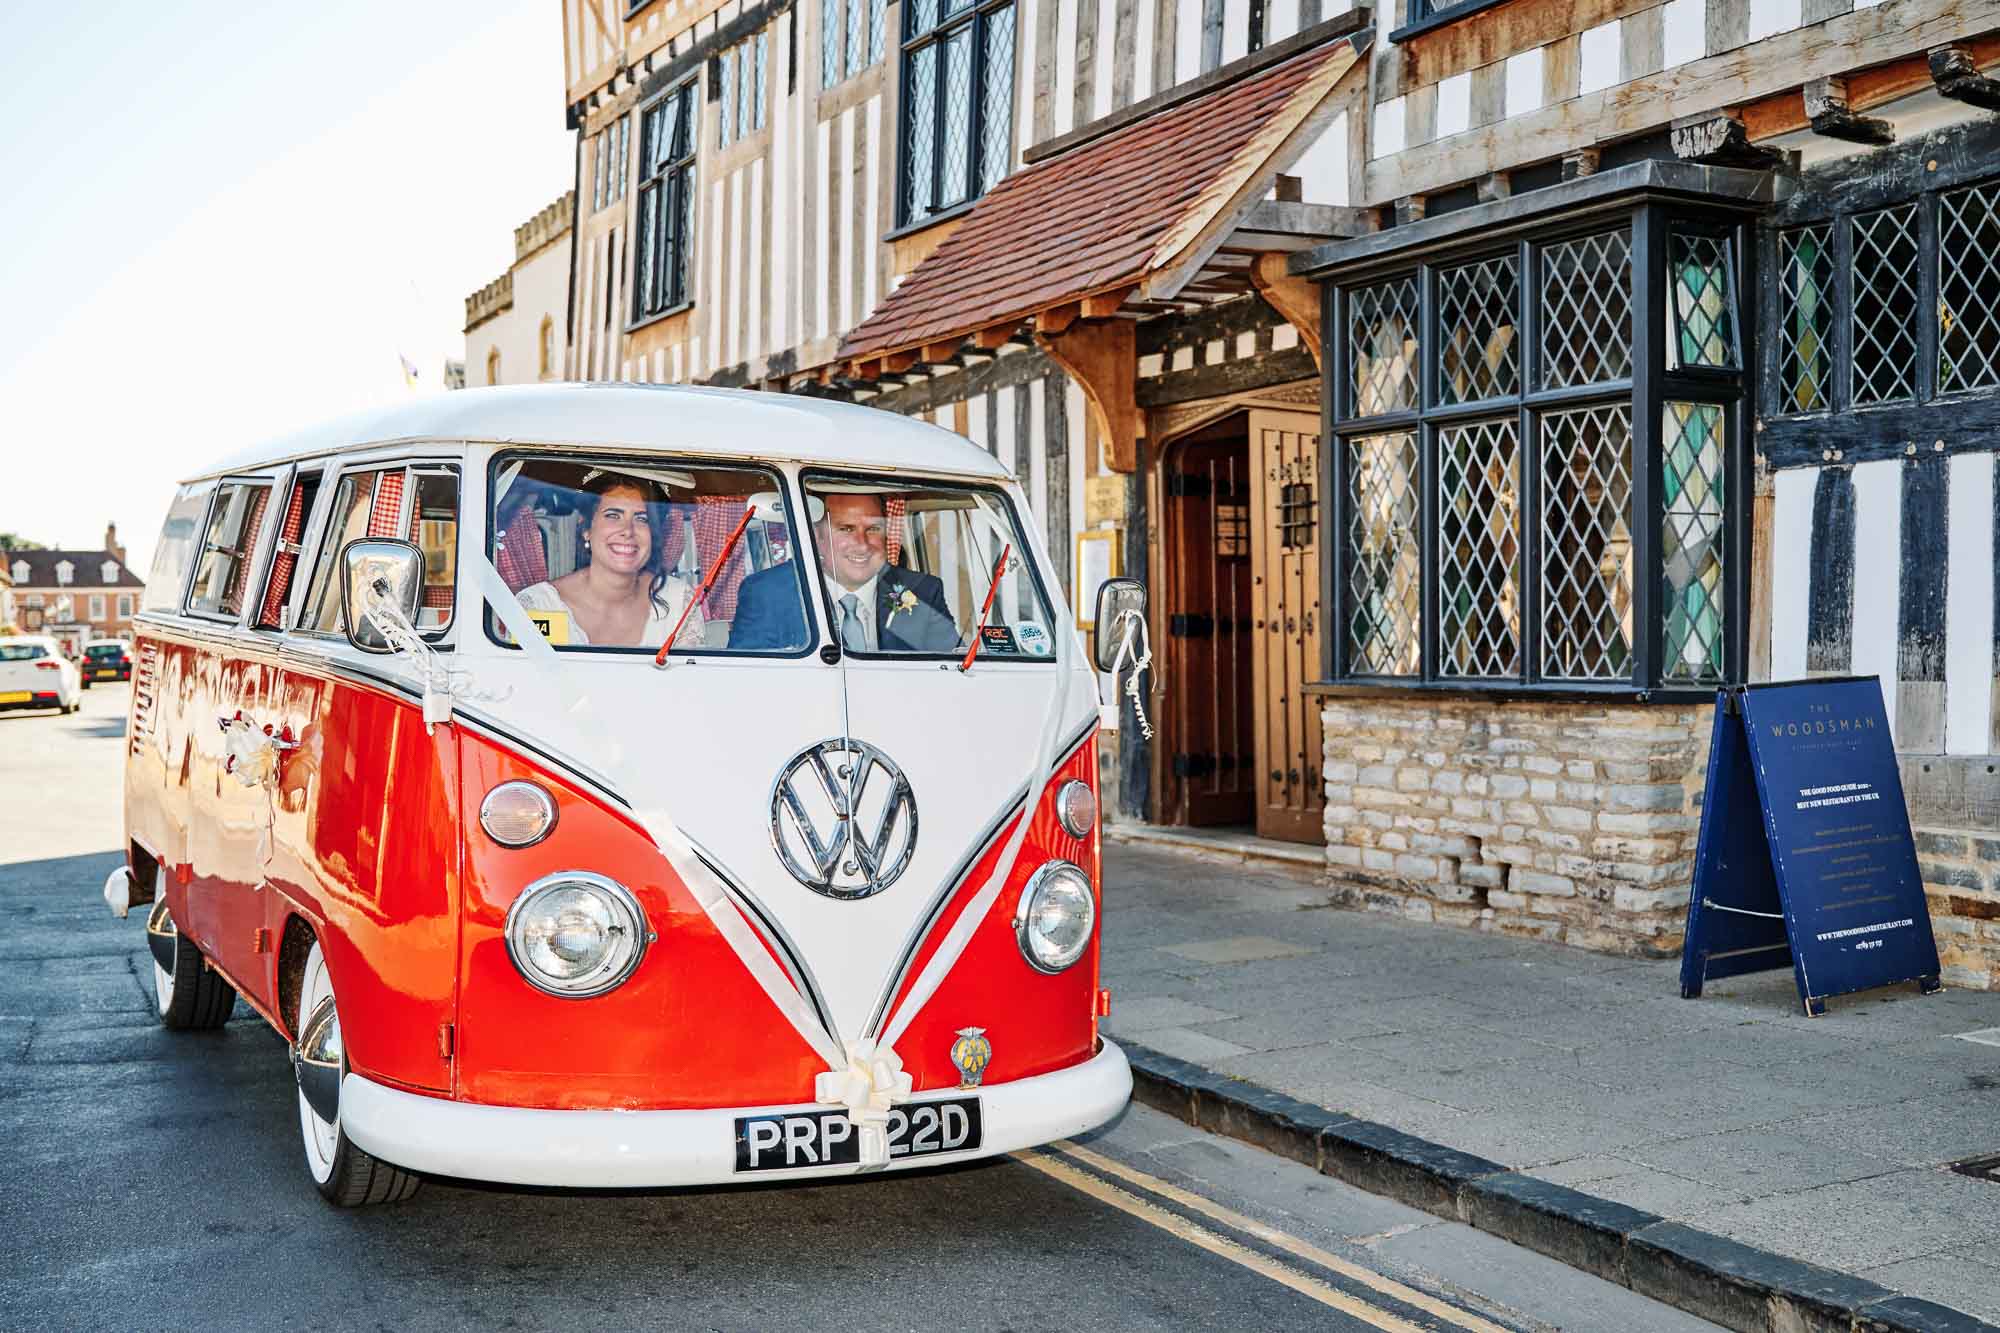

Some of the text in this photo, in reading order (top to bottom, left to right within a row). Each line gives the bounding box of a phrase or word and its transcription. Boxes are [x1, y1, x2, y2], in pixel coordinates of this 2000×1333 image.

[1809, 704, 1831, 713] THE
[1771, 717, 1874, 737] WOODSMAN
[749, 1114, 852, 1168] PRP
